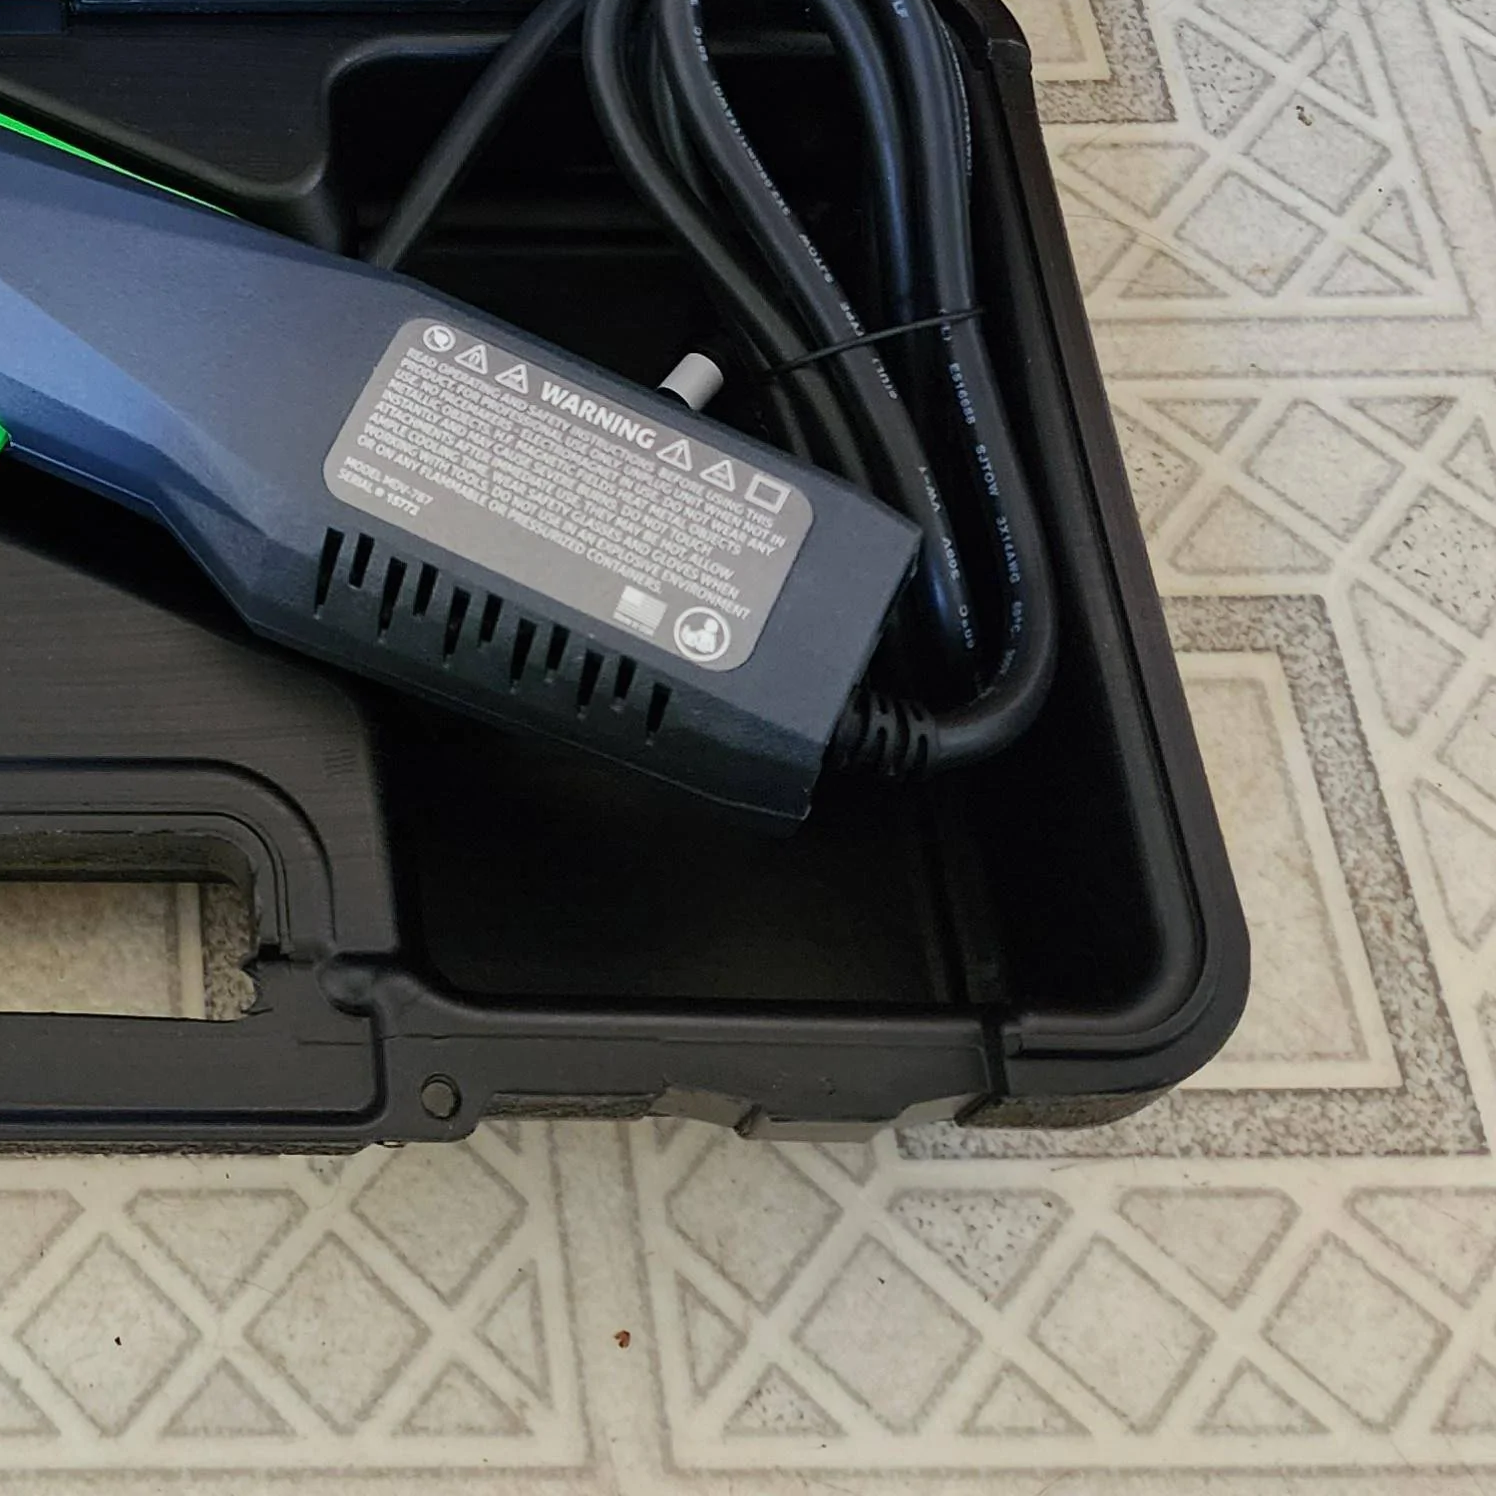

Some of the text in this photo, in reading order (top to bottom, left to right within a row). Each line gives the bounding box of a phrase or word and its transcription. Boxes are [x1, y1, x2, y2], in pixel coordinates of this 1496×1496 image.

[343, 456, 382, 482] MODEL
[355, 433, 376, 450] OR
[374, 442, 395, 460] ON
[392, 452, 420, 472] ANY
[418, 464, 490, 506] FLAMMABLE
[487, 498, 508, 516] OR
[506, 508, 587, 555] PRESSURIZED
[374, 400, 456, 446] ATTACHMENTS
[454, 438, 493, 464] AFTER
[491, 456, 555, 494] IMMEDIATE
[581, 499, 616, 523] THEY
[613, 515, 642, 536] MAY
[641, 528, 660, 544] BE
[688, 551, 735, 581] ALLOW
[381, 389, 443, 425] INSTANTLY
[440, 417, 468, 437] AND
[465, 429, 495, 450] MAY
[491, 442, 533, 468] CAUSE
[530, 461, 577, 489] SEVERE
[619, 503, 642, 521] DO
[641, 513, 668, 533] NOT
[669, 527, 713, 555] TOUCH
[387, 378, 442, 410] METALLIC
[515, 439, 579, 476] MAGNETIC
[577, 469, 617, 495] FIELDS
[615, 488, 648, 509] HEAT
[647, 503, 689, 529] METAL
[687, 522, 743, 555] OBJECTS
[419, 380, 440, 396] NO
[617, 474, 634, 489] IN
[660, 495, 683, 512] DO
[682, 505, 710, 525] NOT
[709, 518, 748, 543] WEAR
[747, 536, 775, 556] ANY
[437, 361, 502, 398] OPERATING
[500, 391, 527, 410] AND
[526, 404, 571, 431] SAFETY
[658, 466, 706, 495] BEFORE
[705, 489, 745, 514] USING
[744, 507, 774, 528] THIS
[455, 384, 481, 402] FOR
[479, 395, 562, 441] PROFESSIONAL
[563, 435, 590, 454] USE
[622, 463, 674, 494] UNPLUG
[672, 487, 703, 508] UNIT
[702, 502, 742, 527] WHEN
[741, 520, 769, 540] NOT
[769, 534, 785, 547] IN
[541, 381, 657, 451] WARNING
[362, 422, 420, 457] WORKING
[417, 449, 451, 473] WITH
[490, 485, 513, 503] DO
[510, 495, 538, 515] NOT
[536, 507, 562, 527] USE
[561, 520, 578, 535] IN
[575, 527, 596, 544] AN
[595, 536, 663, 577] EXPLOSIVE
[660, 568, 750, 620] ENVIRONMENT
[368, 411, 409, 437] AMPLE
[406, 429, 461, 463] COOLING
[489, 470, 528, 496] WEAR
[525, 487, 571, 517] SAFETY
[568, 508, 624, 543] GLASSES
[622, 534, 652, 556] AND
[650, 548, 700, 580] GLOVES
[697, 571, 740, 599] WHEN
